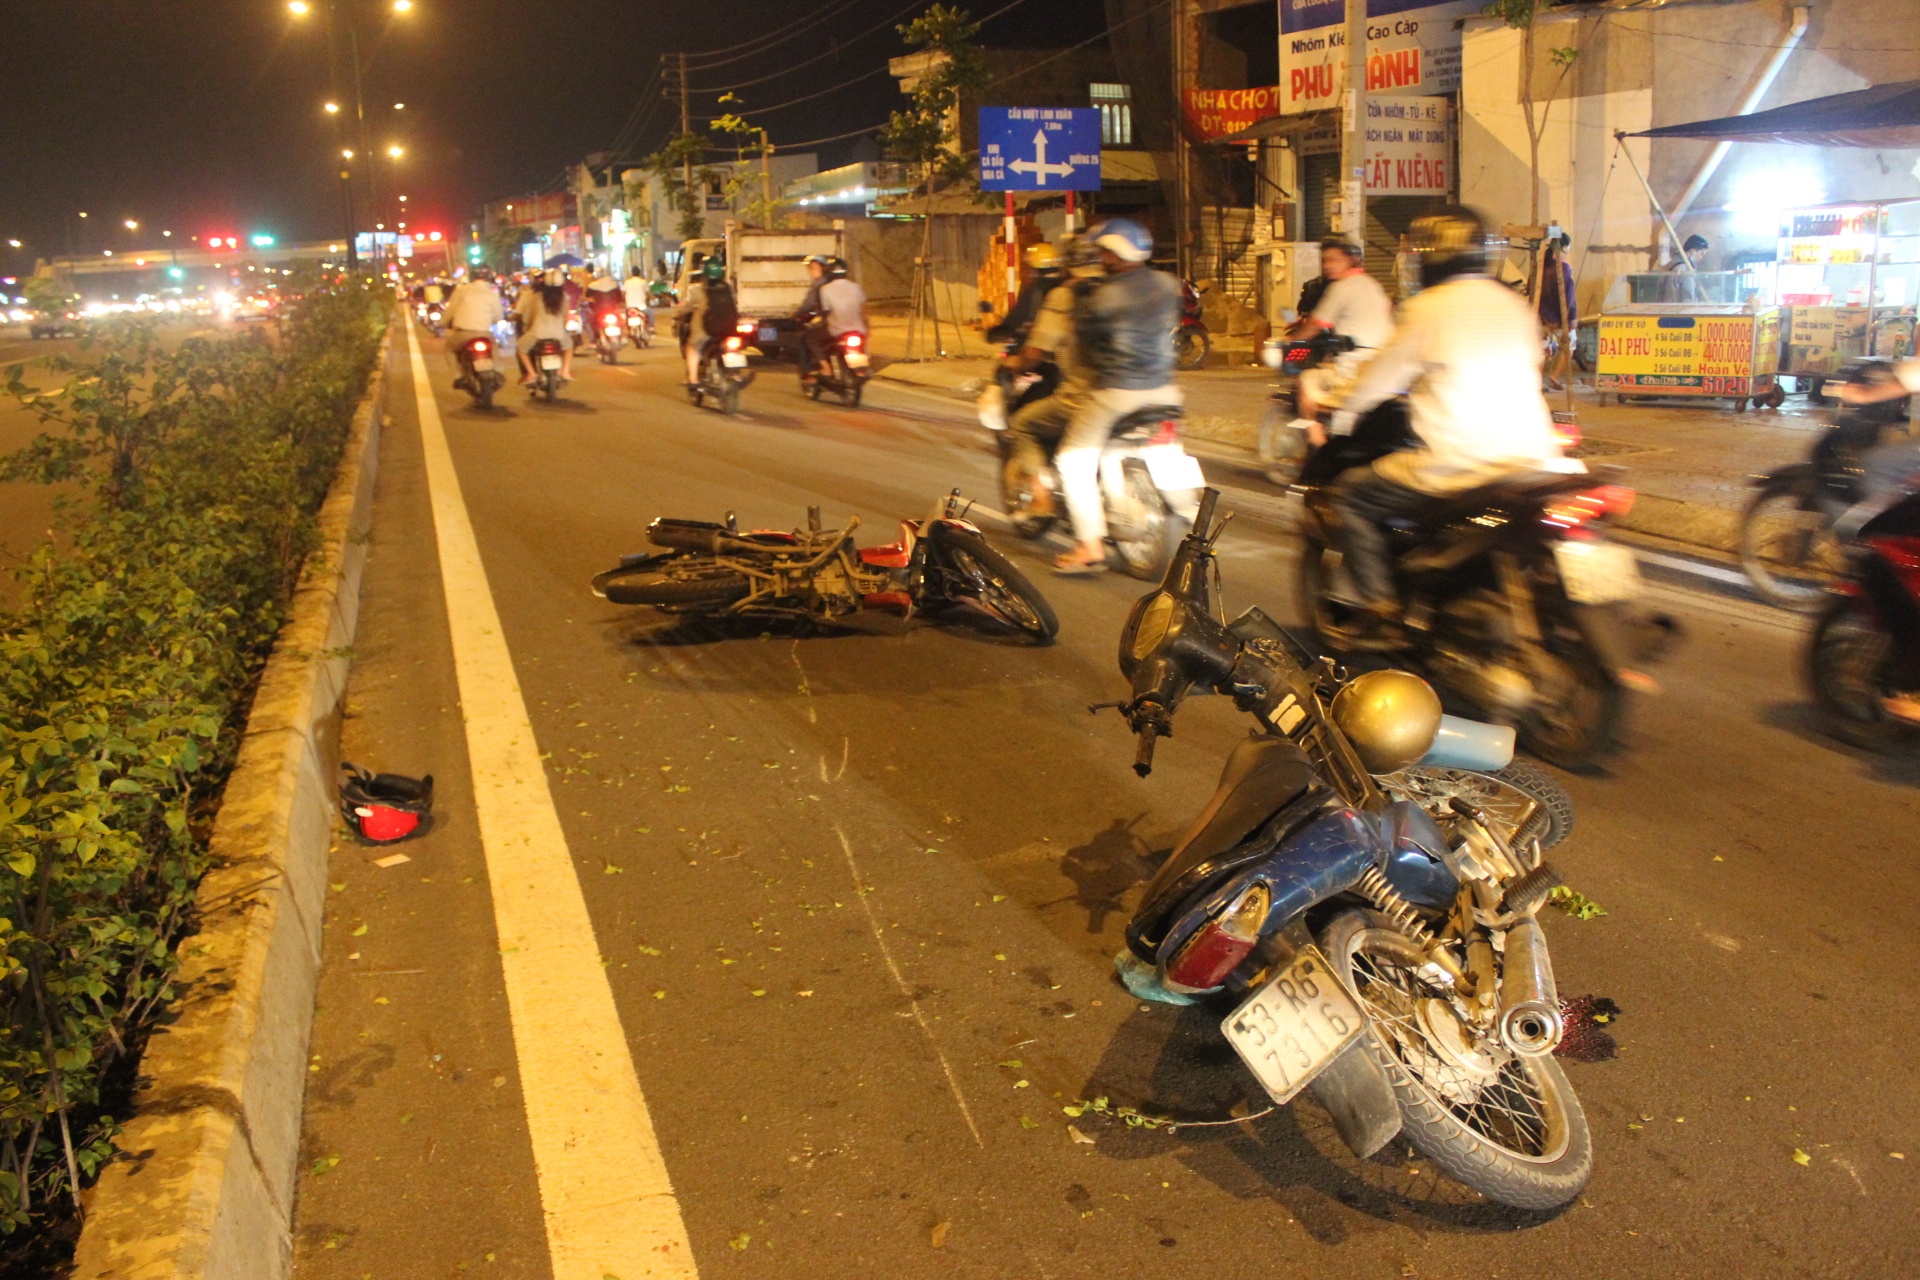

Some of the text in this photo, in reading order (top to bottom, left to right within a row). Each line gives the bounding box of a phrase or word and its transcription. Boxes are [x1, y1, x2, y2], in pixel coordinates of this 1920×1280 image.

[1291, 37, 1325, 54] Nhôm
[1366, 26, 1390, 40] Cao
[1395, 17, 1419, 37] Cấp
[1341, 47, 1420, 91] ÀNH
[1229, 89, 1269, 110] CHO
[1364, 126, 1381, 142] ÁCH
[1600, 337, 1622, 359] ĐẠI
[1698, 363, 1729, 375] Hoàn
[1264, 1003, 1349, 1087] 7316
